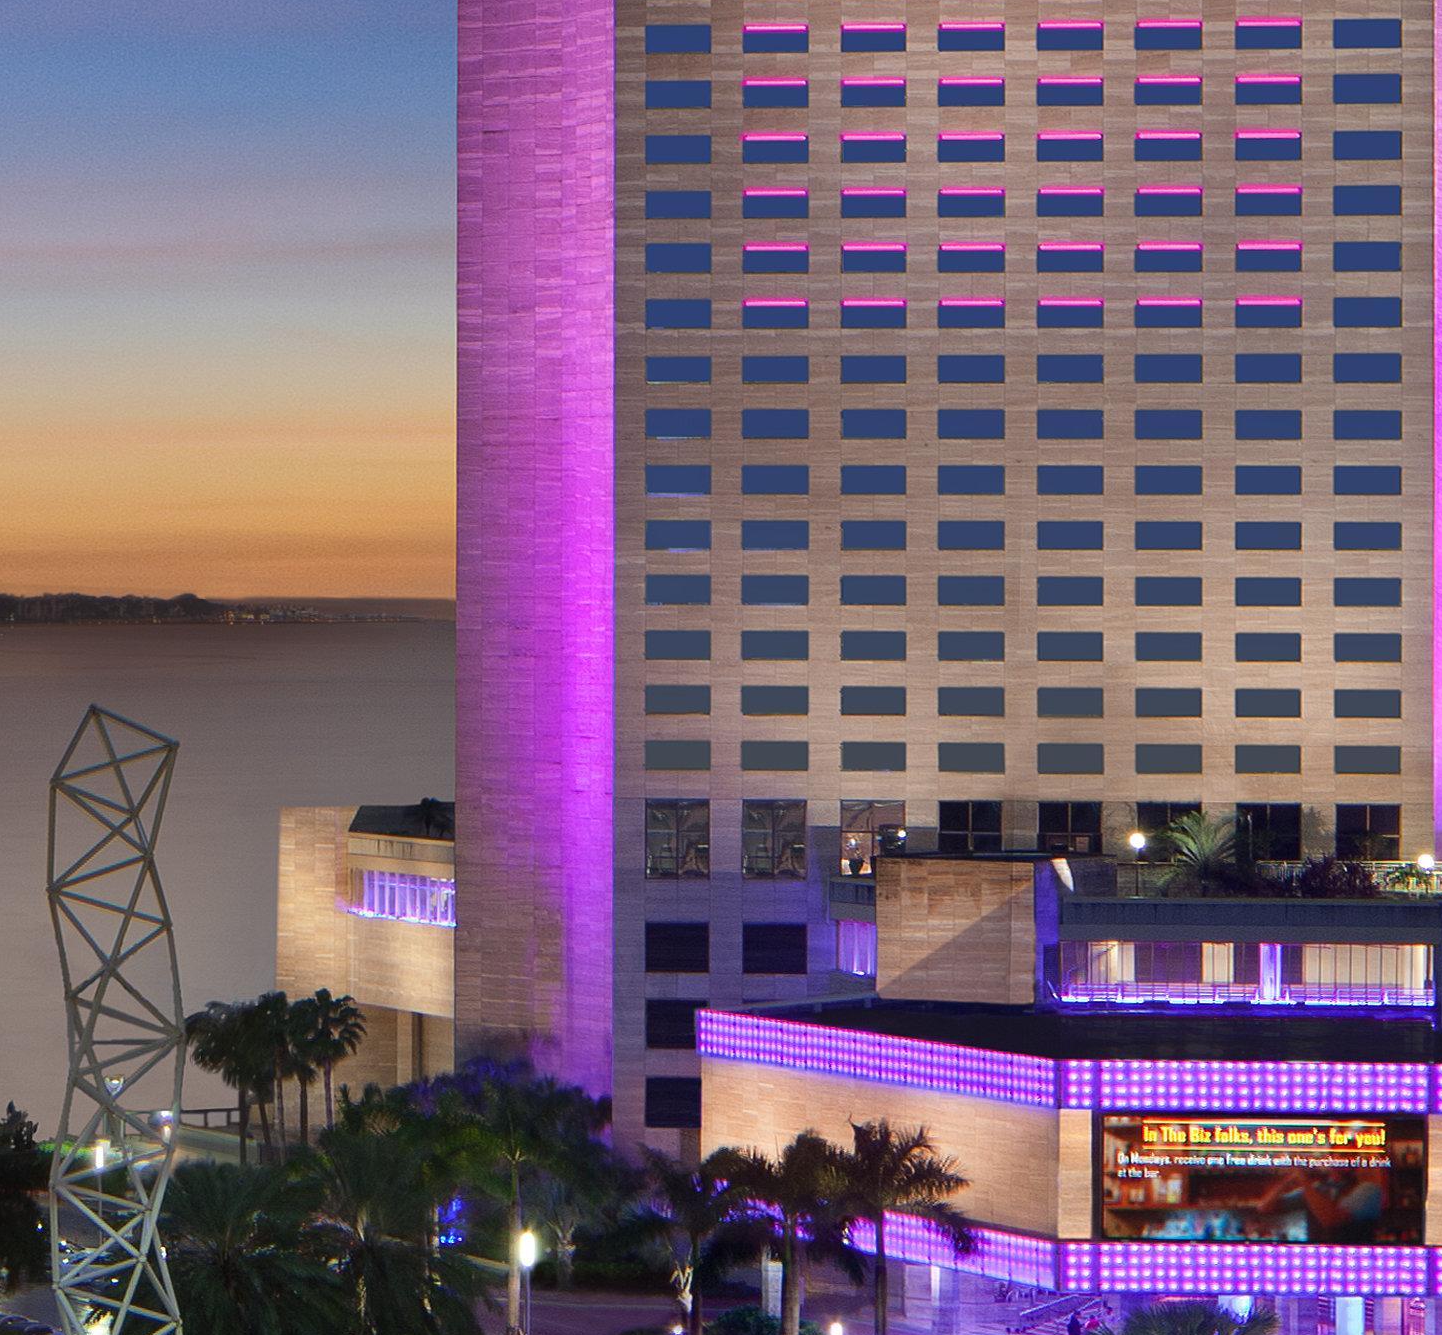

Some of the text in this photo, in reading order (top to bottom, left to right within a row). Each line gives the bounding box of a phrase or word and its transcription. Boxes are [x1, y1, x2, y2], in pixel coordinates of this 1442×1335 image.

[1143, 1126, 1158, 1143] In
[1160, 1126, 1187, 1143] The
[1215, 1126, 1254, 1145] folks,
[1256, 1127, 1285, 1145] this
[1287, 1128, 1326, 1145] one's
[1329, 1128, 1350, 1145] for
[1355, 1129, 1386, 1148] you!
[1247, 1154, 1272, 1166] drink
[1308, 1156, 1350, 1169] purchase
[1368, 1156, 1392, 1168] drink
[1129, 1167, 1143, 1178] the
